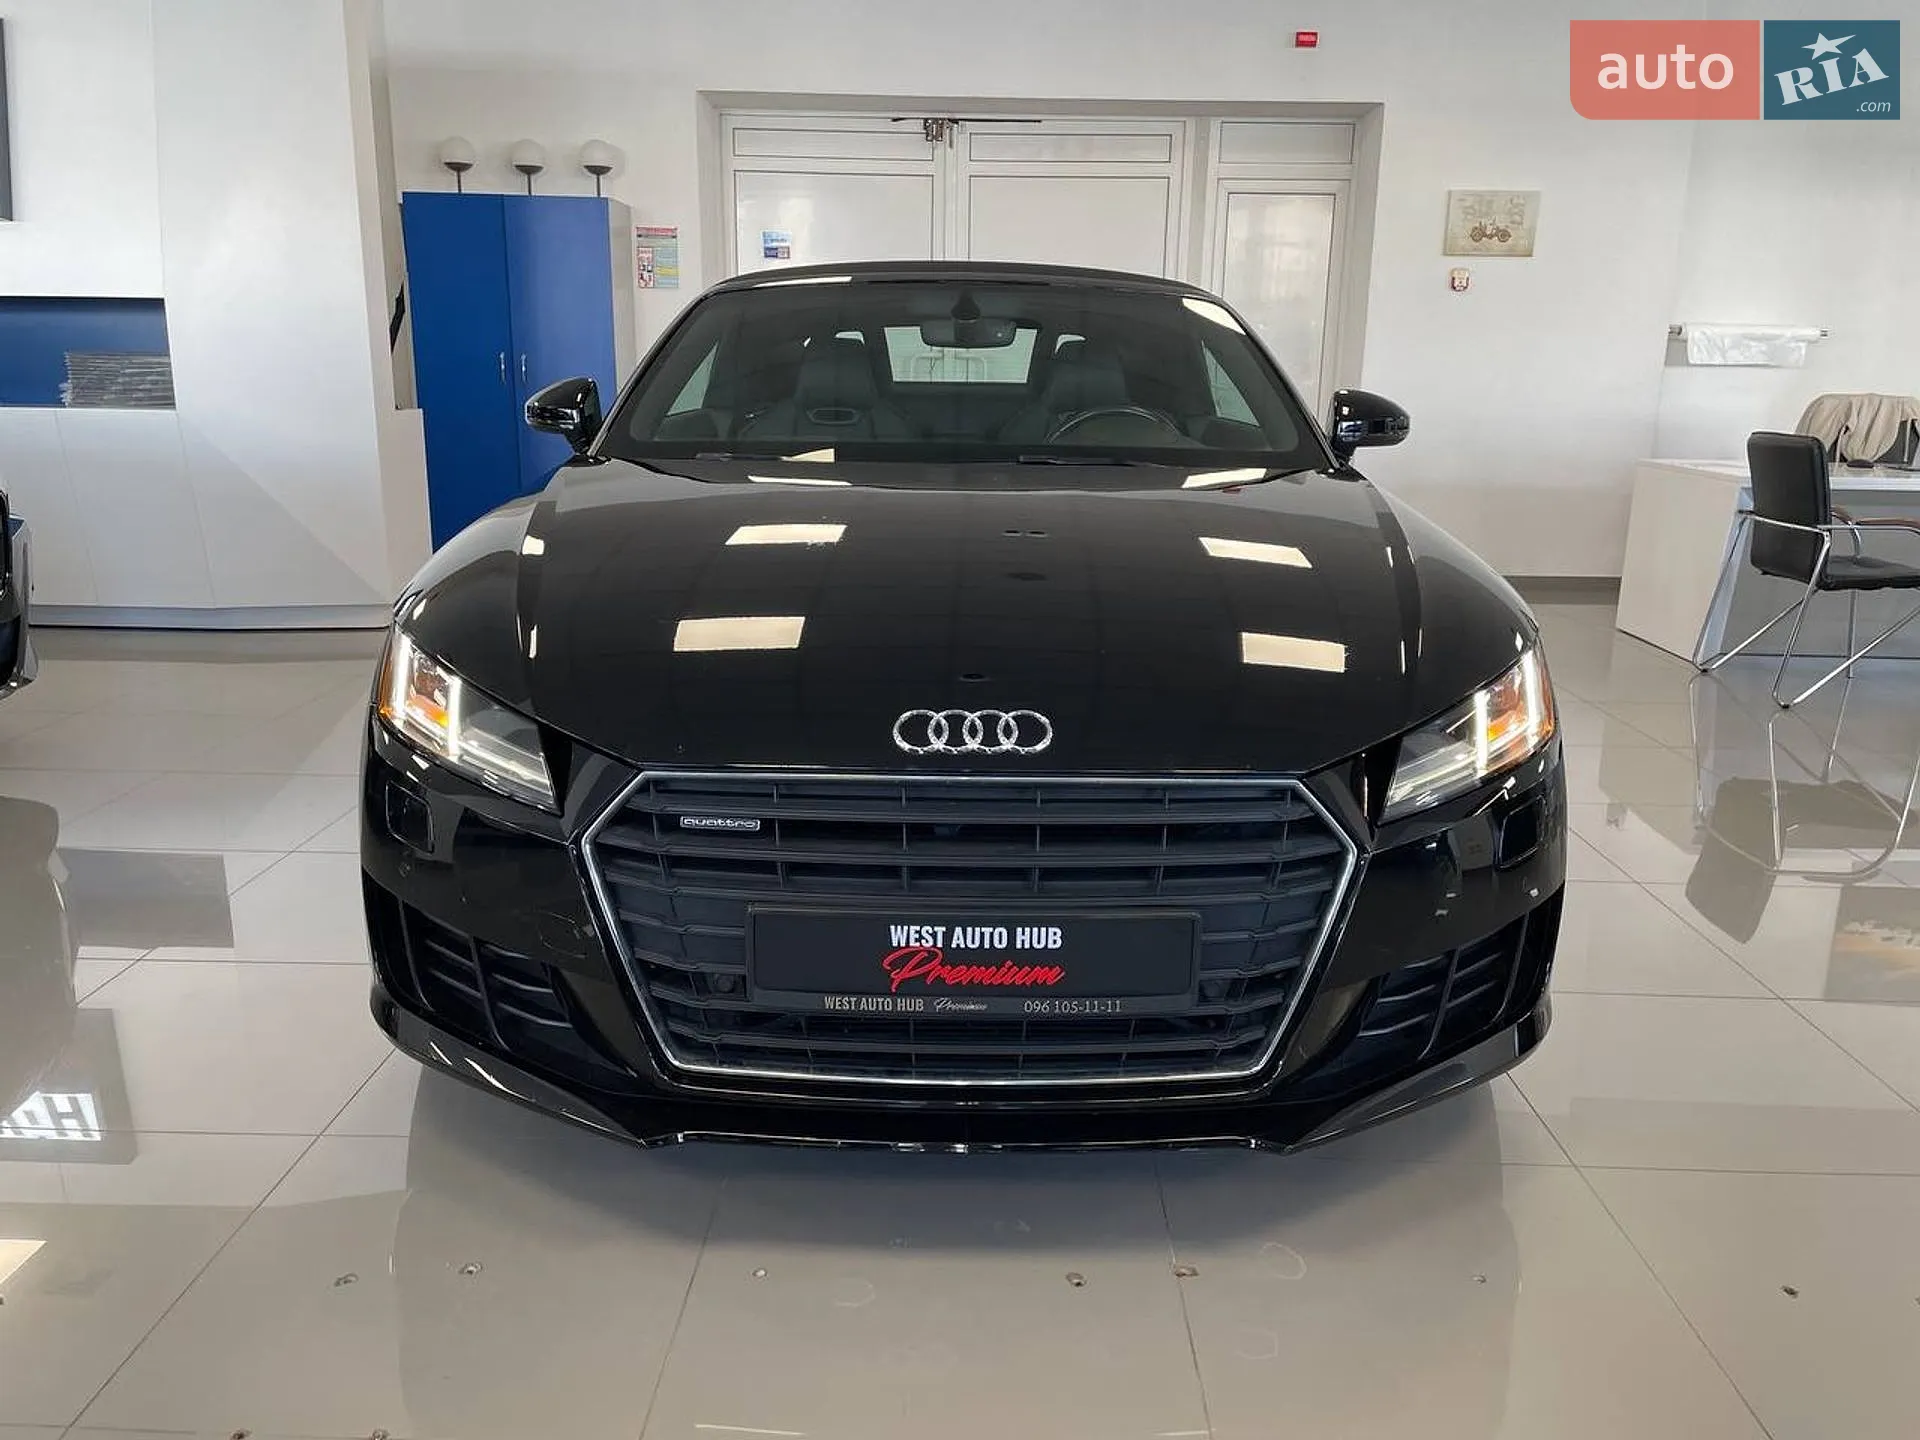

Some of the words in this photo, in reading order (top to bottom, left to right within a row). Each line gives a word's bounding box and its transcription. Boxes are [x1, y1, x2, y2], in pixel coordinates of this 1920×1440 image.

[683, 818, 756, 828] quattro
[890, 925, 946, 949] WEST
[951, 927, 1008, 949] AUTO
[1015, 927, 1063, 949] HUB
[882, 946, 1066, 993] Premium
[824, 996, 857, 1011] WEST
[859, 997, 893, 1012] AUTO
[898, 998, 924, 1012] HUB
[1024, 1001, 1050, 1013] 096
[1055, 1000, 1122, 1014] 105-11-11
